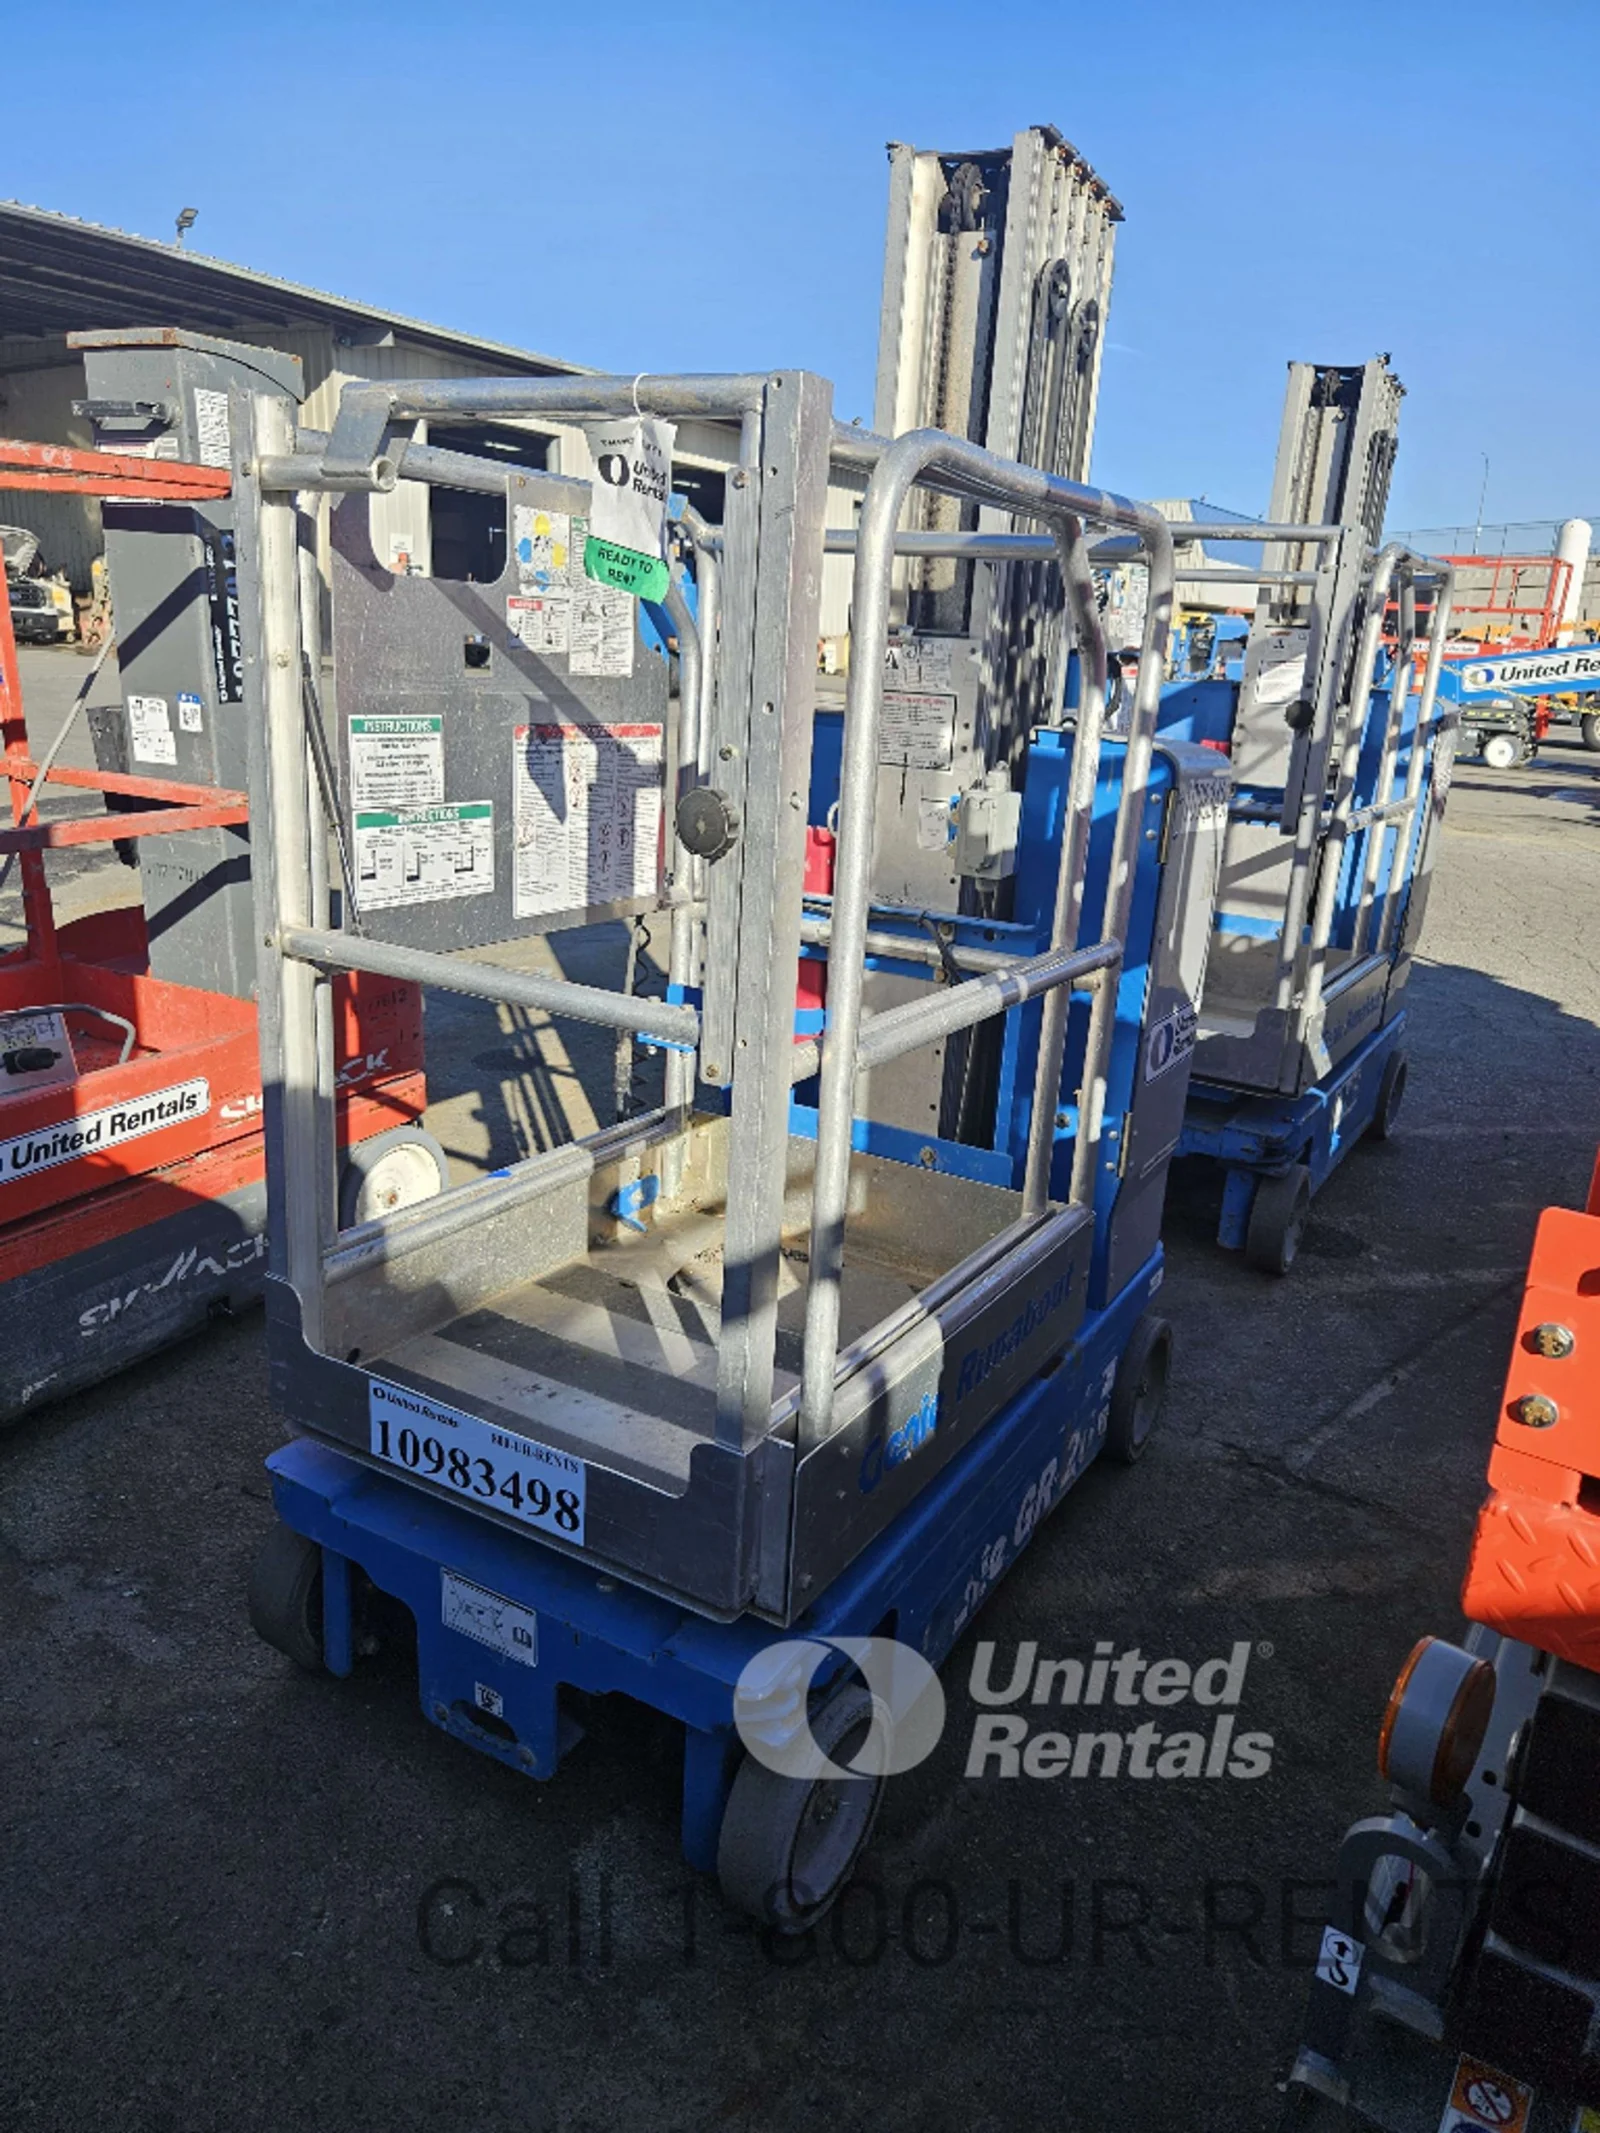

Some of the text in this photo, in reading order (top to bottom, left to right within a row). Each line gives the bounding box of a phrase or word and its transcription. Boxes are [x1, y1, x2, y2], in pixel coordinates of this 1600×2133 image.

[598, 547, 653, 575] READY TO
[1500, 660, 1570, 681] United
[364, 720, 432, 732] INSTRUCTIONS
[10, 1092, 198, 1170] United Rentals
[376, 1420, 581, 1532] 10983498
